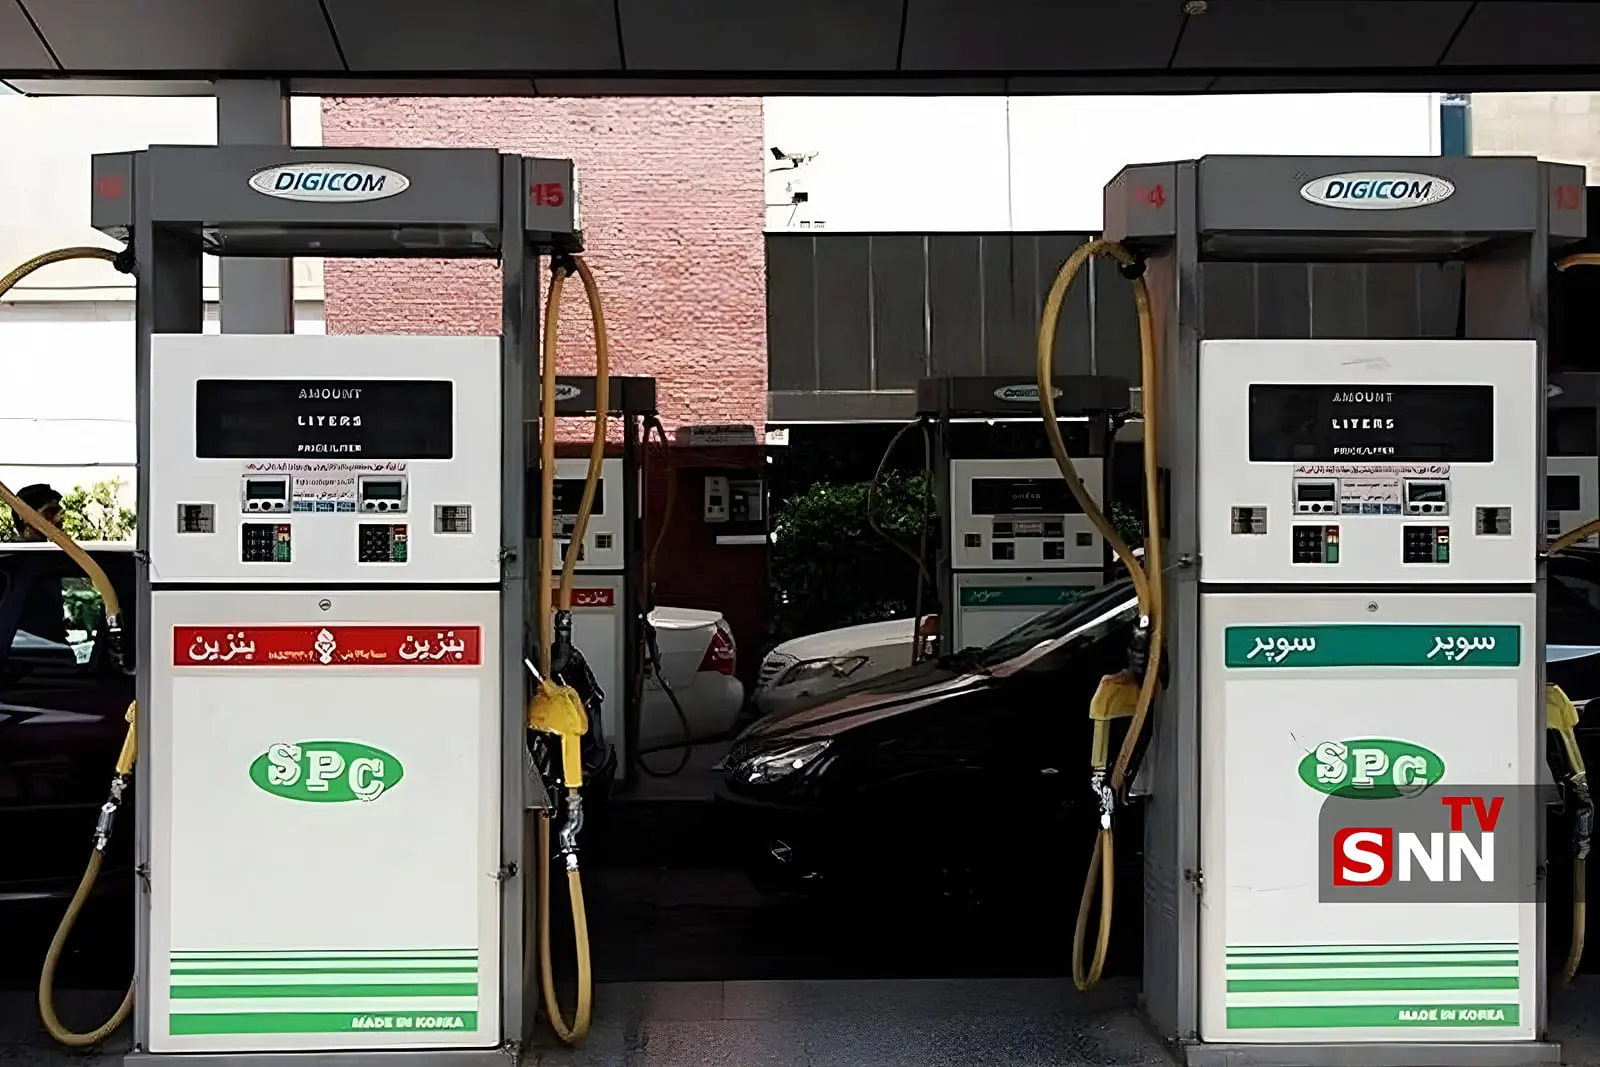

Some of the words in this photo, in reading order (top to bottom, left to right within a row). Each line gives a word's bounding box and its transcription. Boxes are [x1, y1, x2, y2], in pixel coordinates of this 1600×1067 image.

[275, 172, 385, 193] DIGICOM
[1323, 181, 1433, 202] DIGICOM
[188, 630, 256, 662] بنزین
[398, 630, 465, 661] بنزین
[1246, 633, 1317, 663] سوپر
[1427, 632, 1496, 662] سوپر
[267, 742, 386, 803] SPC
[1315, 740, 1428, 800] SPC
[351, 1016, 393, 1029] MADE
[396, 1017, 413, 1029] IN
